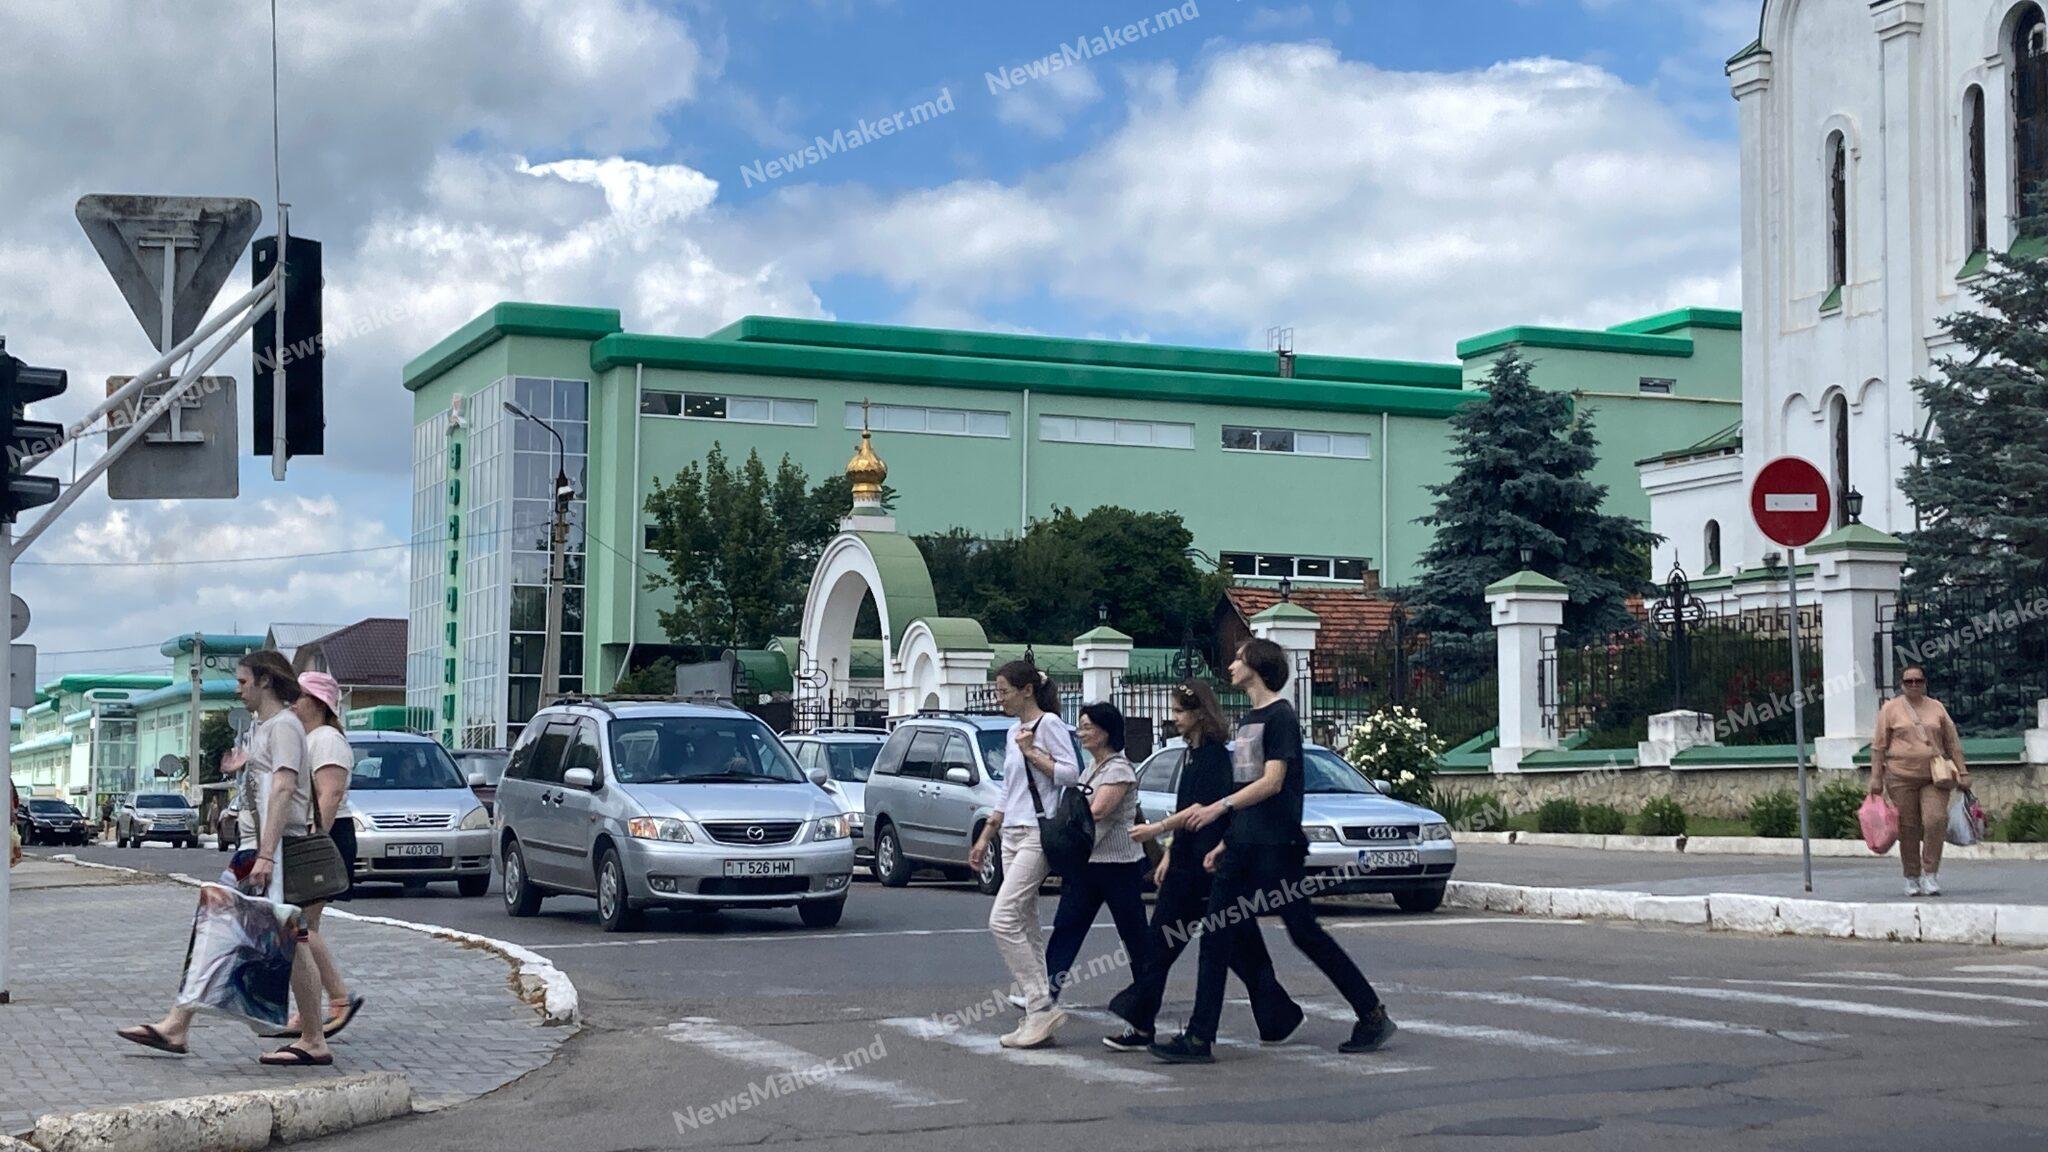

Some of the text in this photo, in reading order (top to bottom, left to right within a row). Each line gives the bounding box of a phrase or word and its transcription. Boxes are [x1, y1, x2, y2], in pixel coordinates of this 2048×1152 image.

[397, 846, 404, 855] T
[406, 846, 423, 855] 403
[738, 862, 790, 874] T 526 HM
